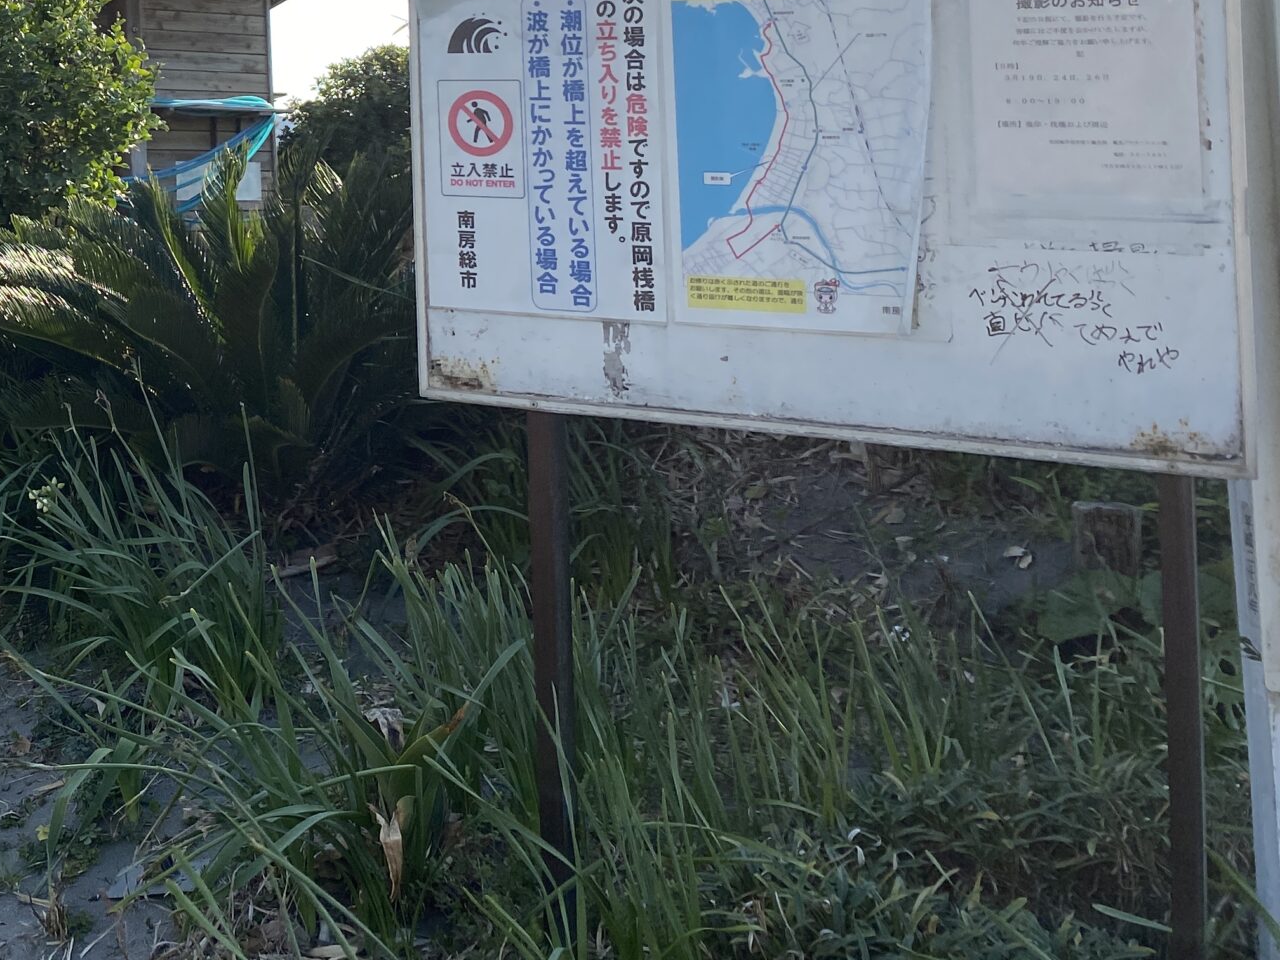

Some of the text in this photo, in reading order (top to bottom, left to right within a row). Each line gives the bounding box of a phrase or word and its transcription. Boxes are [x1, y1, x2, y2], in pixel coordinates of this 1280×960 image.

[450, 162, 515, 178] 立入禁止
[450, 178, 515, 189] DO NOT ENTER
[457, 210, 478, 290] 南房総市
